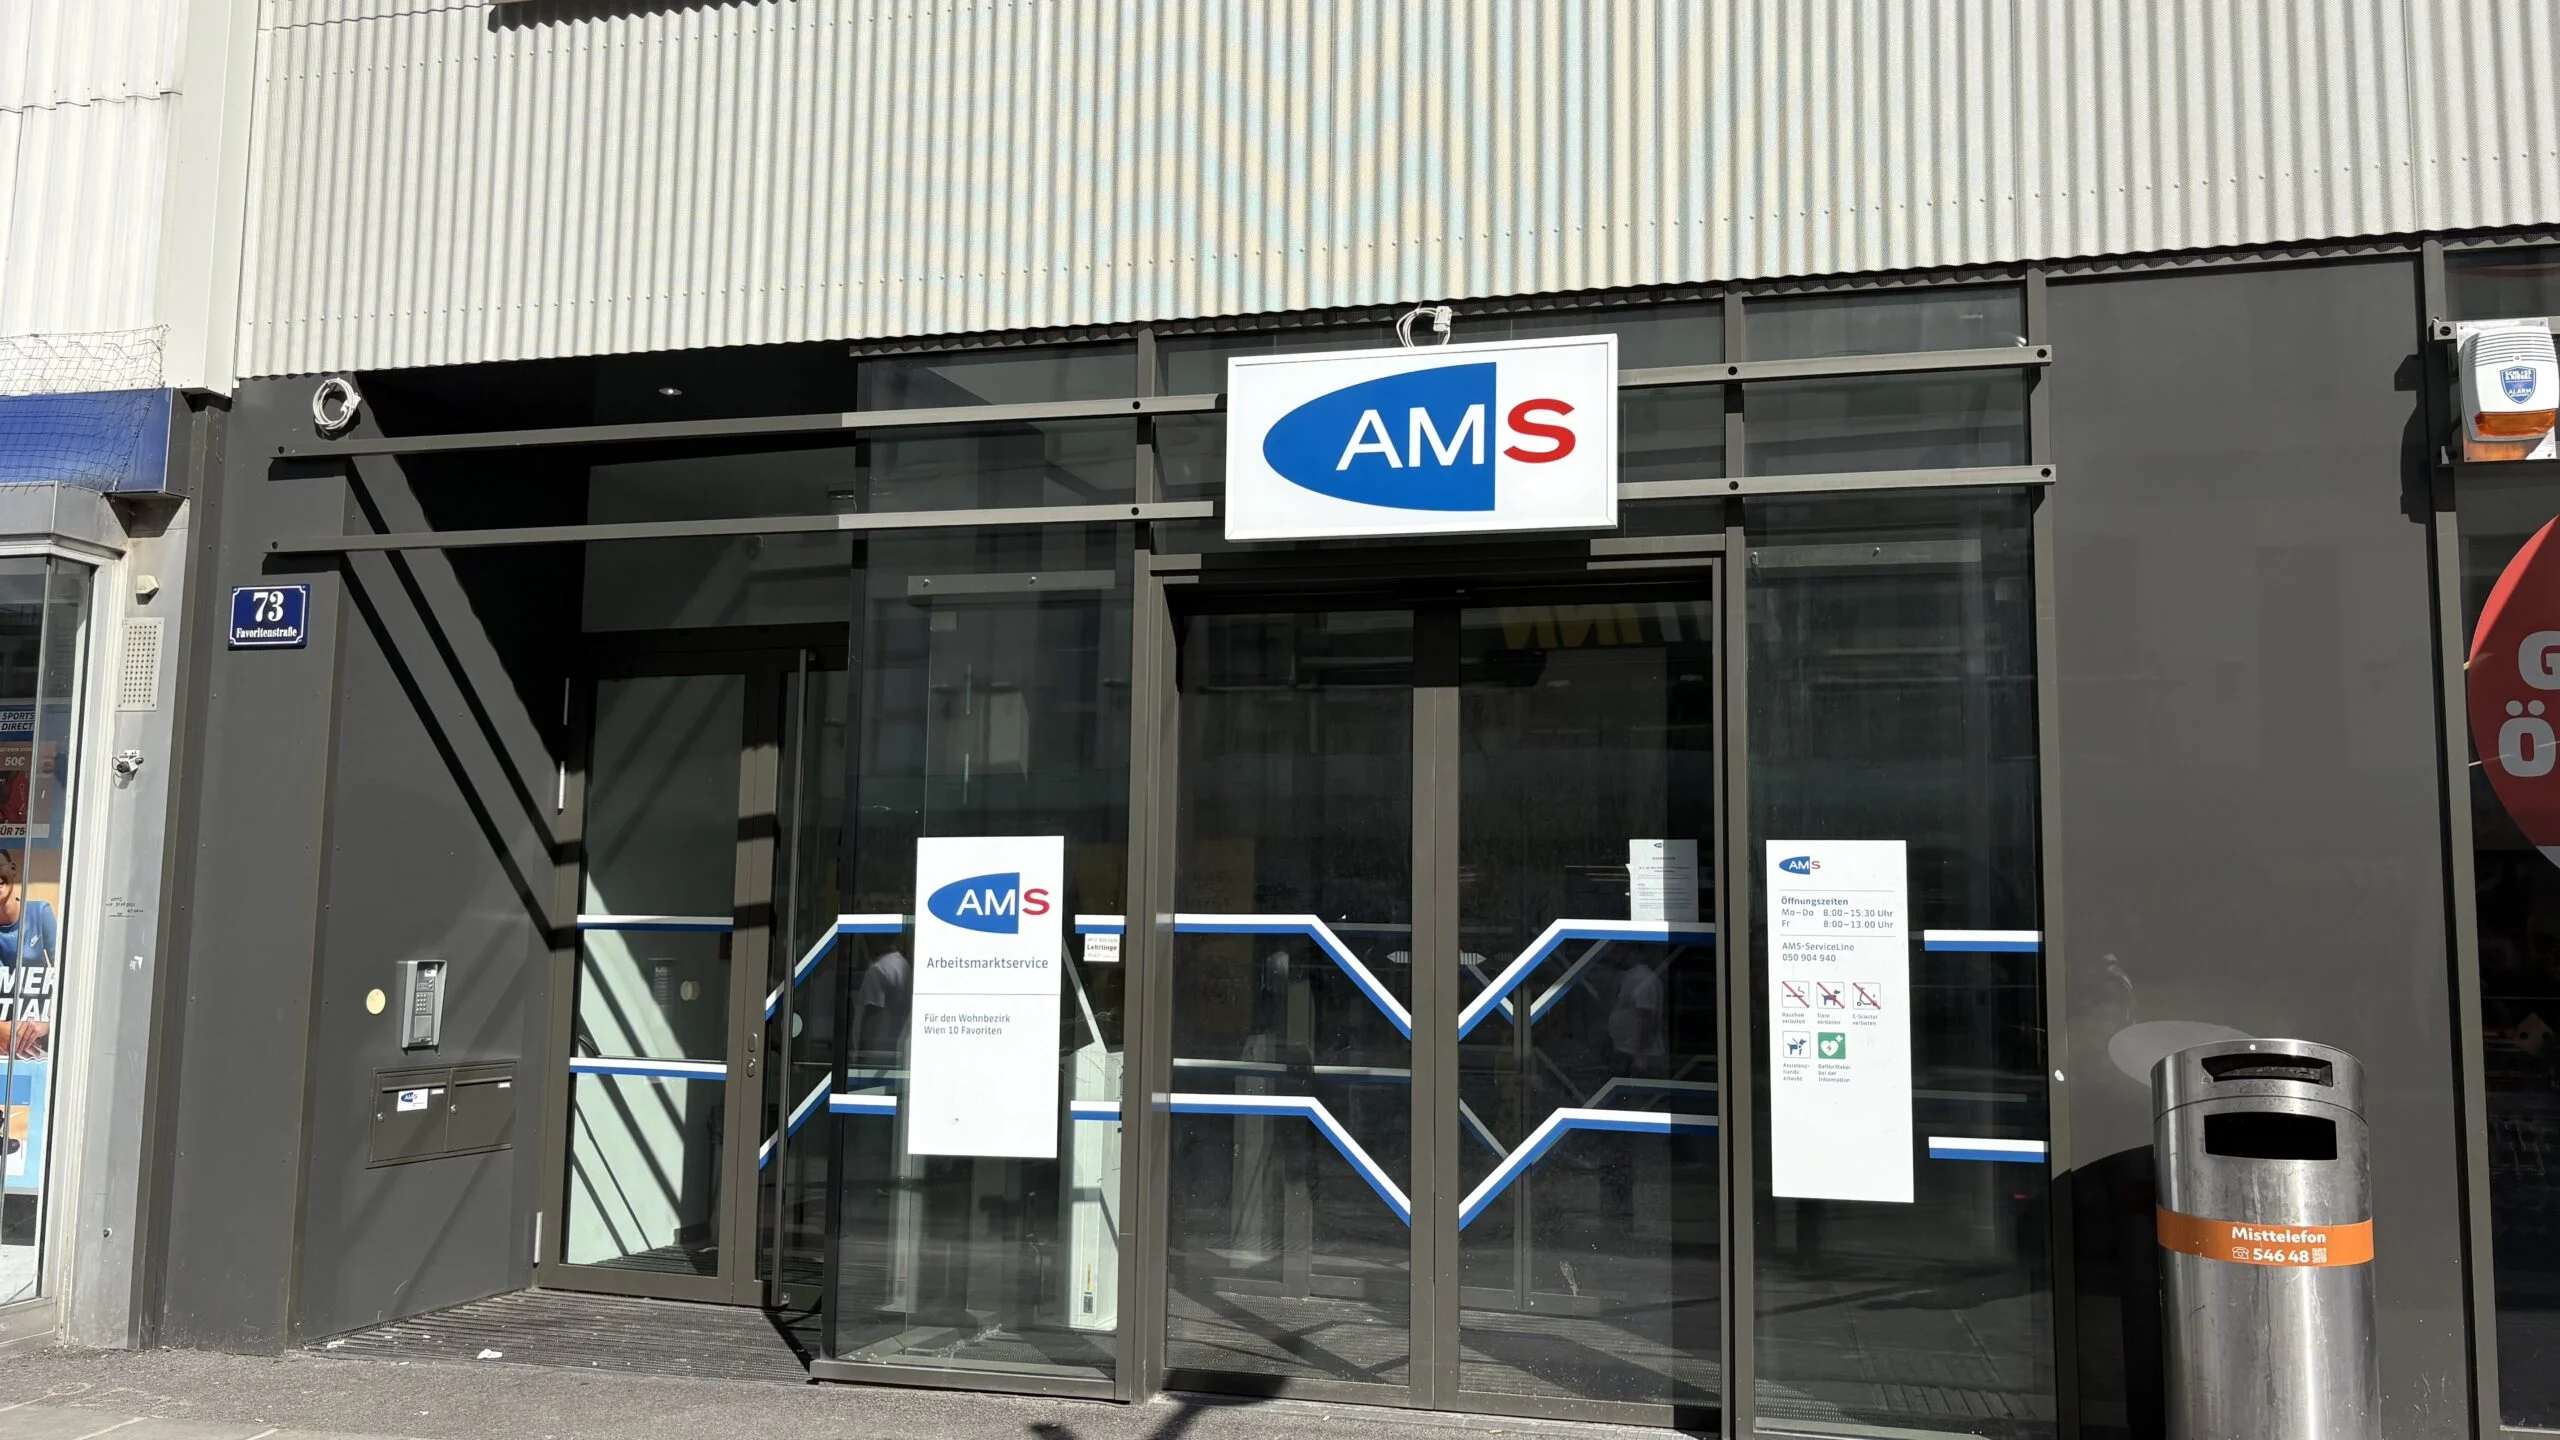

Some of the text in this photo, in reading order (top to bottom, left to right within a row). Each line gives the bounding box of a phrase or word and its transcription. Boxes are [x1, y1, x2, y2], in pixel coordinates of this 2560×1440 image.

[1335, 397, 1577, 471] AMS
[252, 590, 285, 622] 73
[236, 626, 298, 638] Favoritenstraße
[2, 711, 35, 720] SPORTS
[1, 722, 35, 731] DIRECT
[4, 756, 26, 766] 50€
[1788, 860, 1821, 870] AMS
[956, 888, 1050, 916] AMS
[1781, 896, 1849, 906] Öffnungszeiten
[1877, 909, 1893, 918] Uhr
[1781, 920, 1791, 928] Fr
[1877, 920, 1894, 929] Uhr
[1086, 944, 1117, 952] Lehrlinge
[1782, 942, 1855, 951] AMS-ServiceLine
[926, 956, 1049, 969] Arbeitsmarktservice
[1782, 953, 1836, 962] 050 904 940
[924, 1013, 1011, 1023] Für den Wohnbezirk
[923, 1025, 1002, 1035] Wien 10 Favoriten
[2231, 1226, 2327, 1244] Misttelefon
[2252, 1247, 2310, 1264] 546 48
